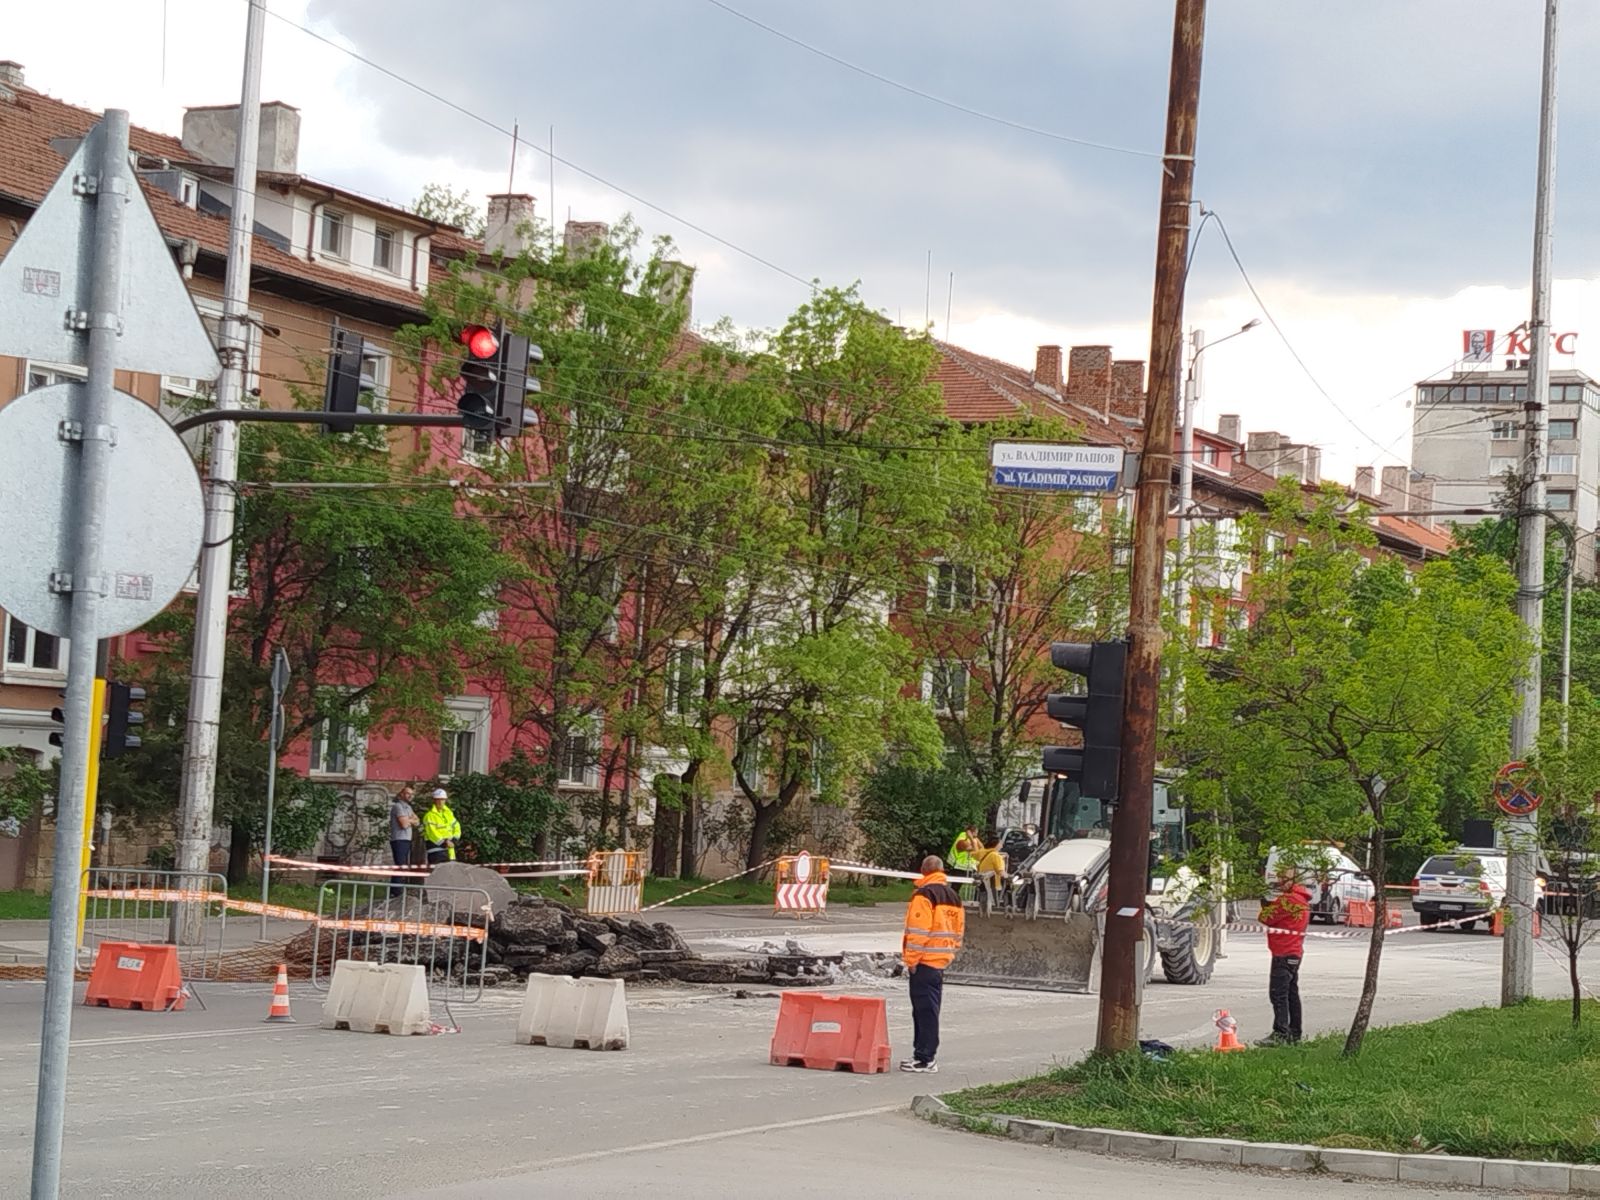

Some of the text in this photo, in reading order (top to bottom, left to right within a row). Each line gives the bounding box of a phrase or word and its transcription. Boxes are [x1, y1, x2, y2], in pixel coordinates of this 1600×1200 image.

[1505, 332, 1578, 355] KC
[1001, 451, 1116, 464] ул. ВЛАДИМИР ПАШОВ
[1004, 472, 1110, 486] ul. VLADIMIR PASHOV
